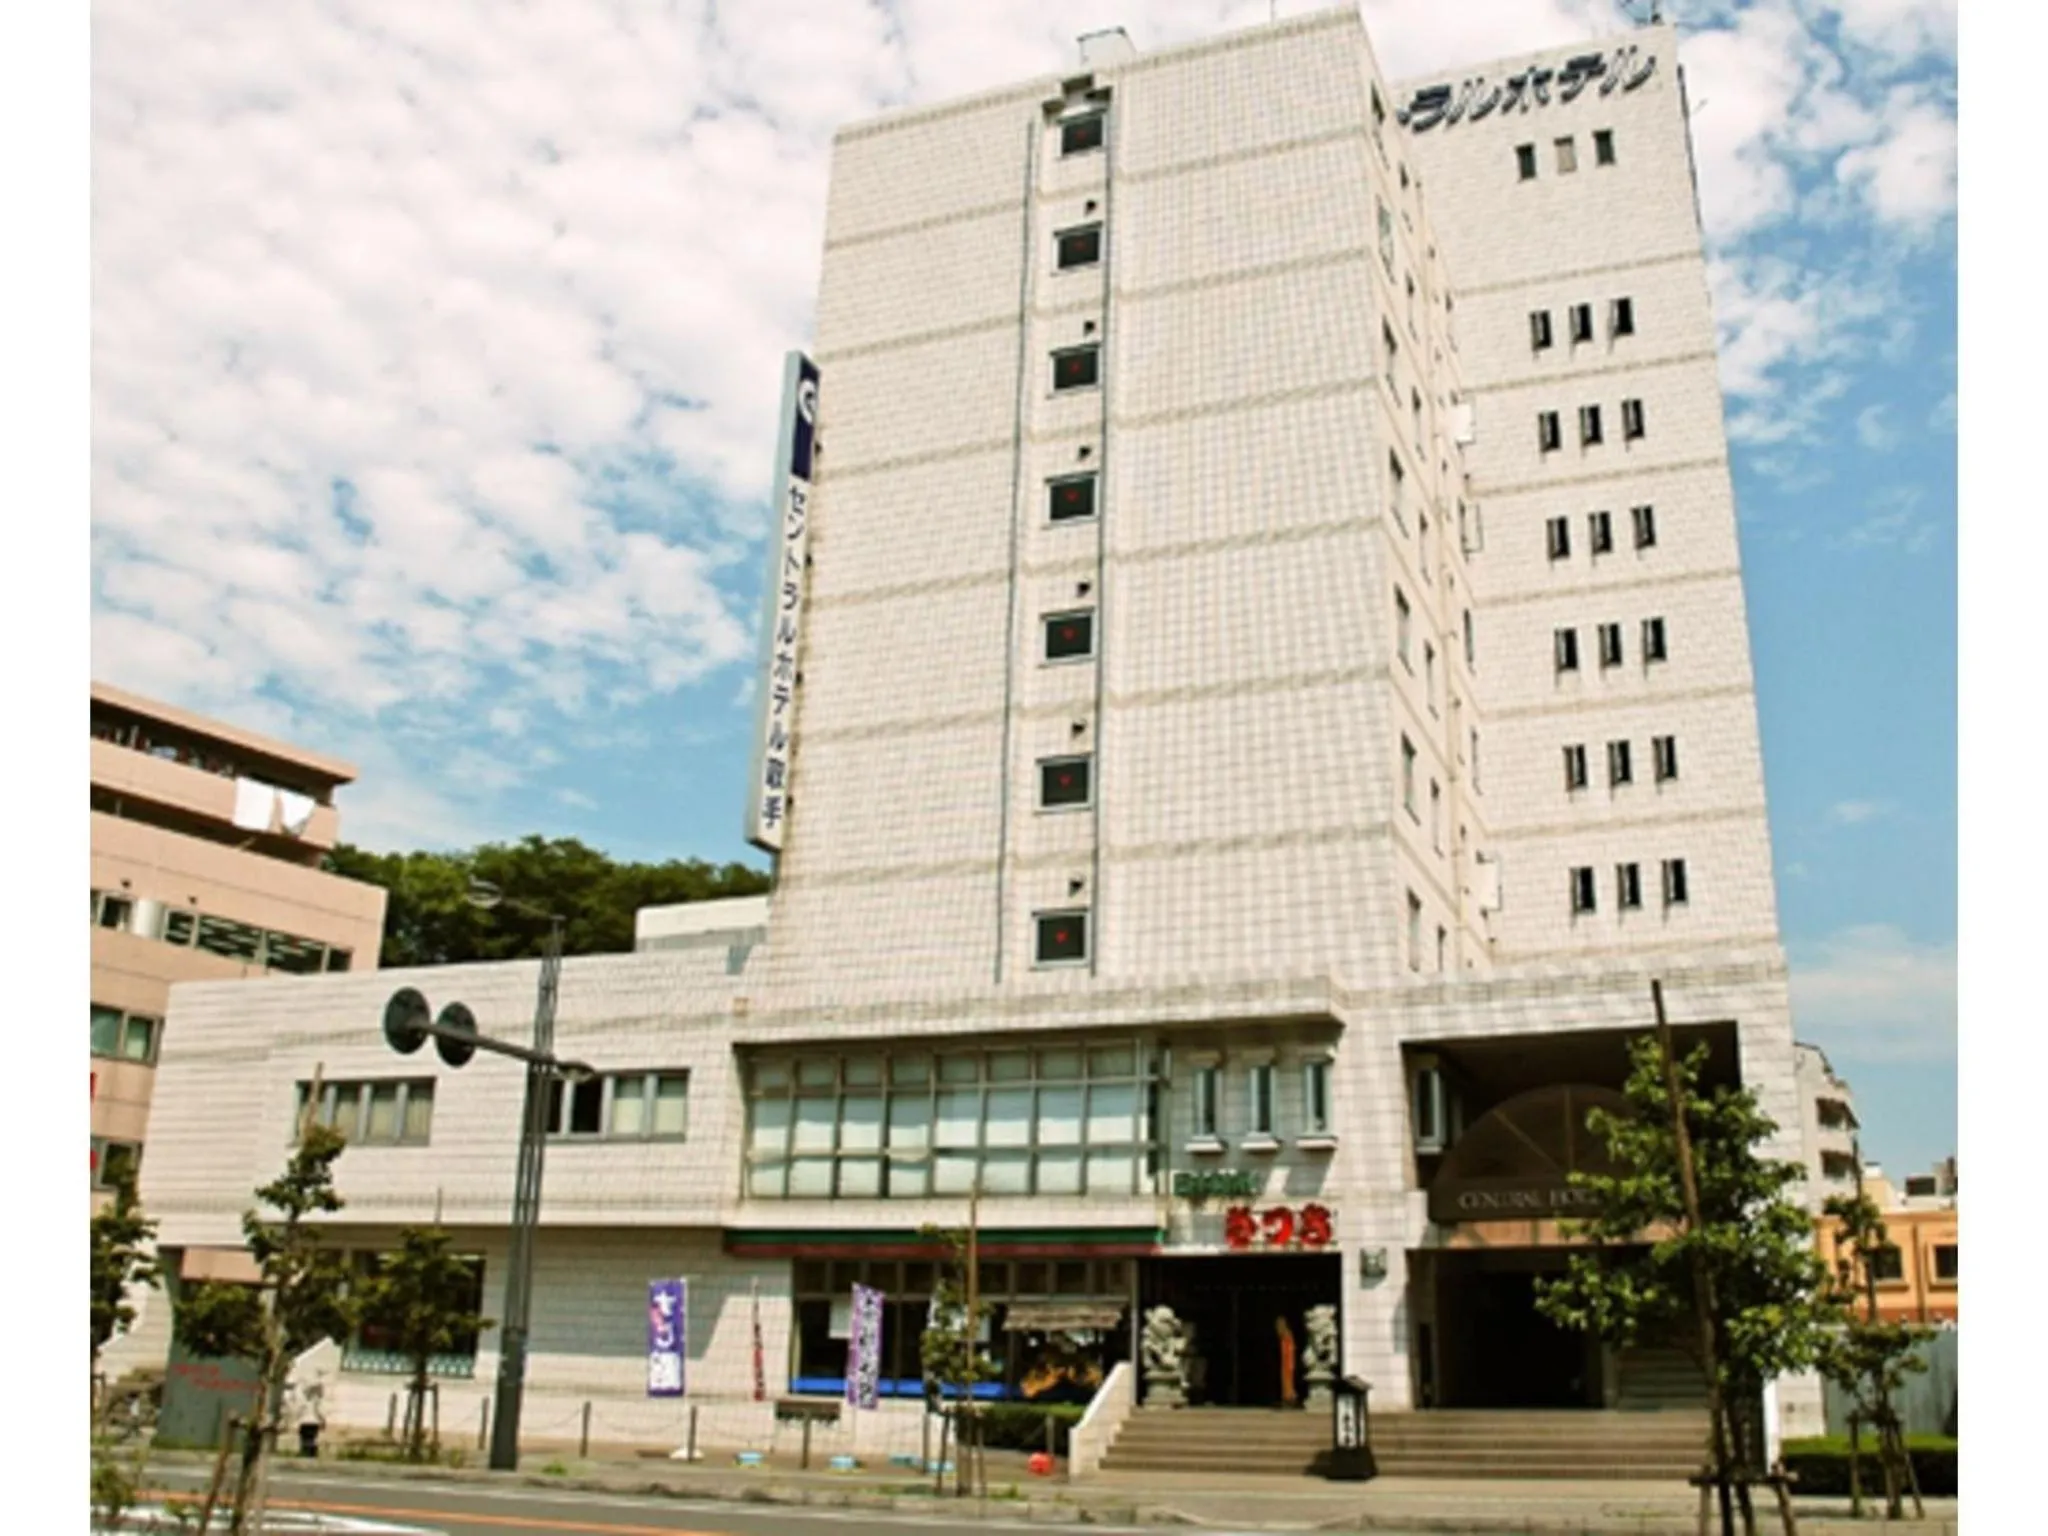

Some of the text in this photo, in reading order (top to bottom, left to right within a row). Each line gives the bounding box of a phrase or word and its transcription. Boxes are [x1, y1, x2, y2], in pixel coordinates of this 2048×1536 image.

[1397, 45, 1656, 134] ラルホテル
